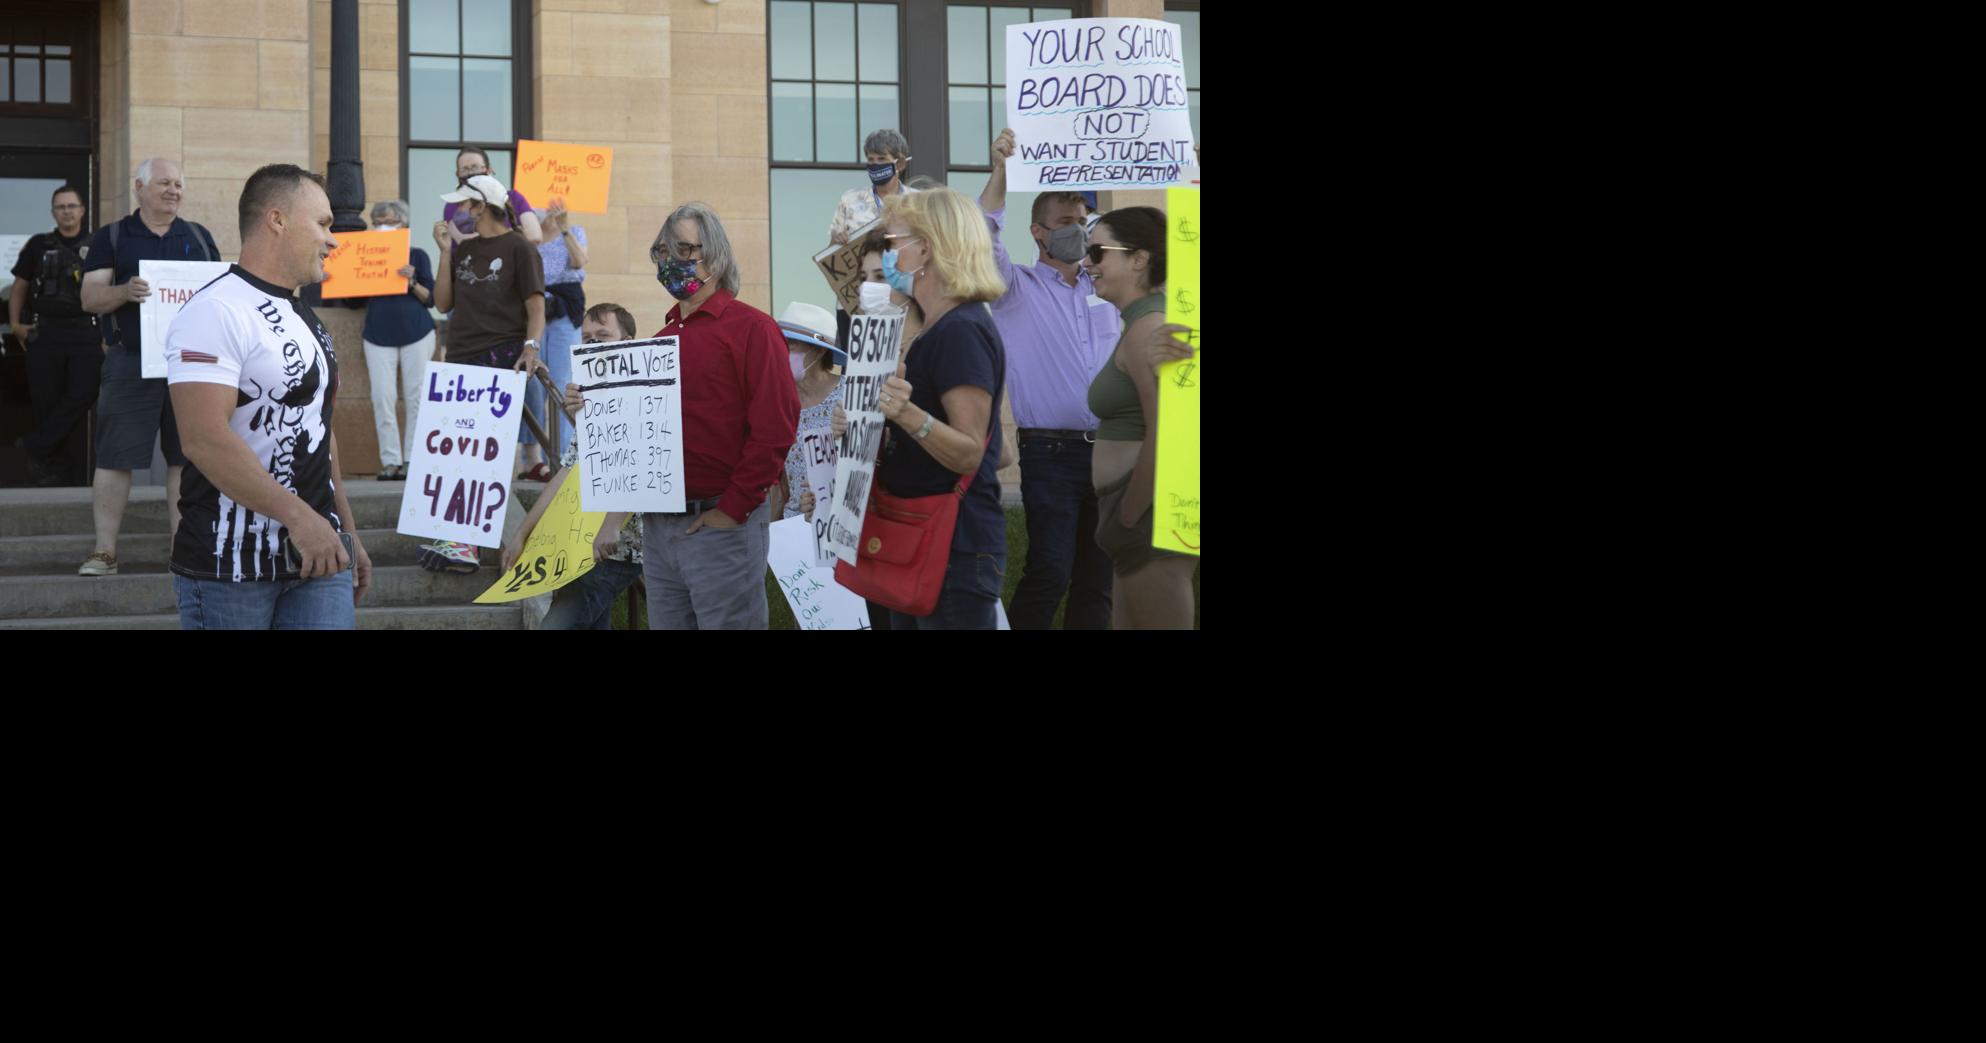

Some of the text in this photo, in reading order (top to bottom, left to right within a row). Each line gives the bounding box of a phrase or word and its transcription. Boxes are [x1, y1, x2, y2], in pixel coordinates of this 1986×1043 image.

[1023, 24, 1181, 67] YOUR SCHOOL
[1018, 73, 1186, 110] BOARD DOES
[1084, 112, 1145, 135] NOT
[1020, 139, 1189, 164] WANT STUDENT
[254, 297, 286, 338] We
[281, 338, 307, 393] The
[582, 350, 675, 379] TOTAL VOTE
[428, 372, 512, 418] Liberty
[638, 393, 668, 417] 1371
[455, 418, 475, 429] AND
[640, 420, 672, 440] 1314
[648, 445, 672, 470] 397
[423, 473, 442, 517] 4
[647, 471, 672, 495] 295
[790, 578, 825, 607] Risk
